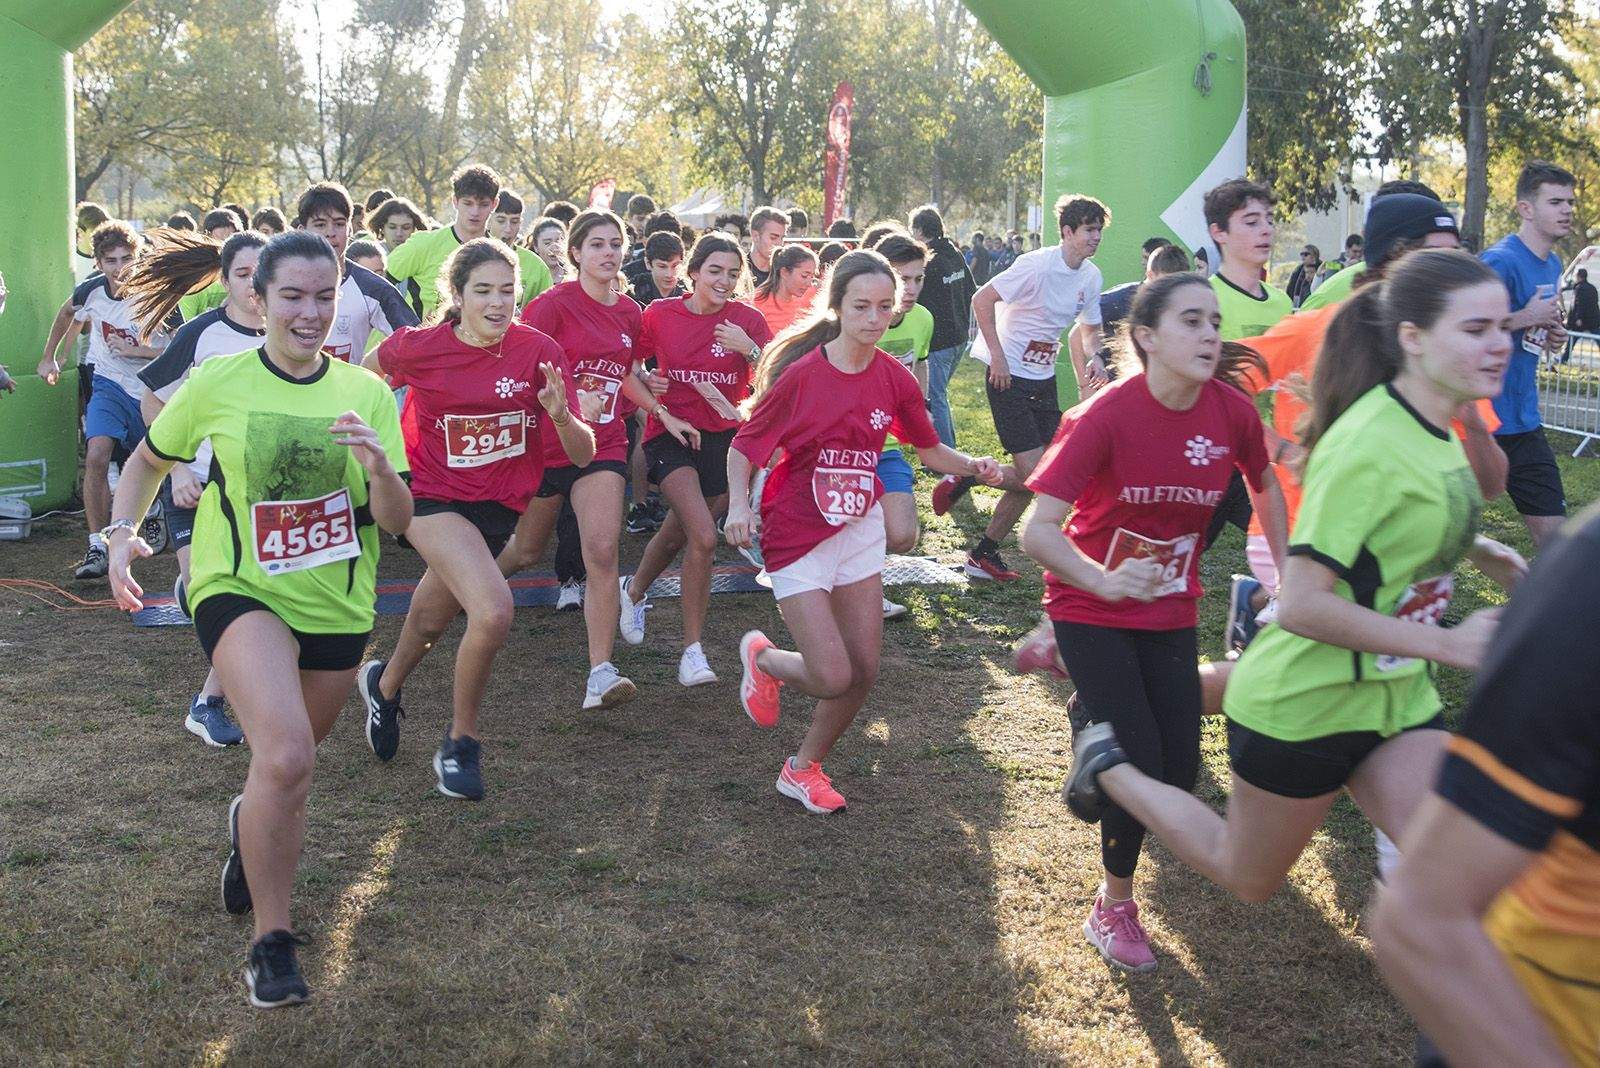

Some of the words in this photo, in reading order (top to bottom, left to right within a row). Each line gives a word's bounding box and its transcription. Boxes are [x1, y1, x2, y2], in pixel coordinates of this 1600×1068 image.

[461, 429, 512, 455] 294
[827, 490, 866, 515] 289
[1117, 485, 1223, 507] ATLETISME
[262, 516, 348, 557] 4565
